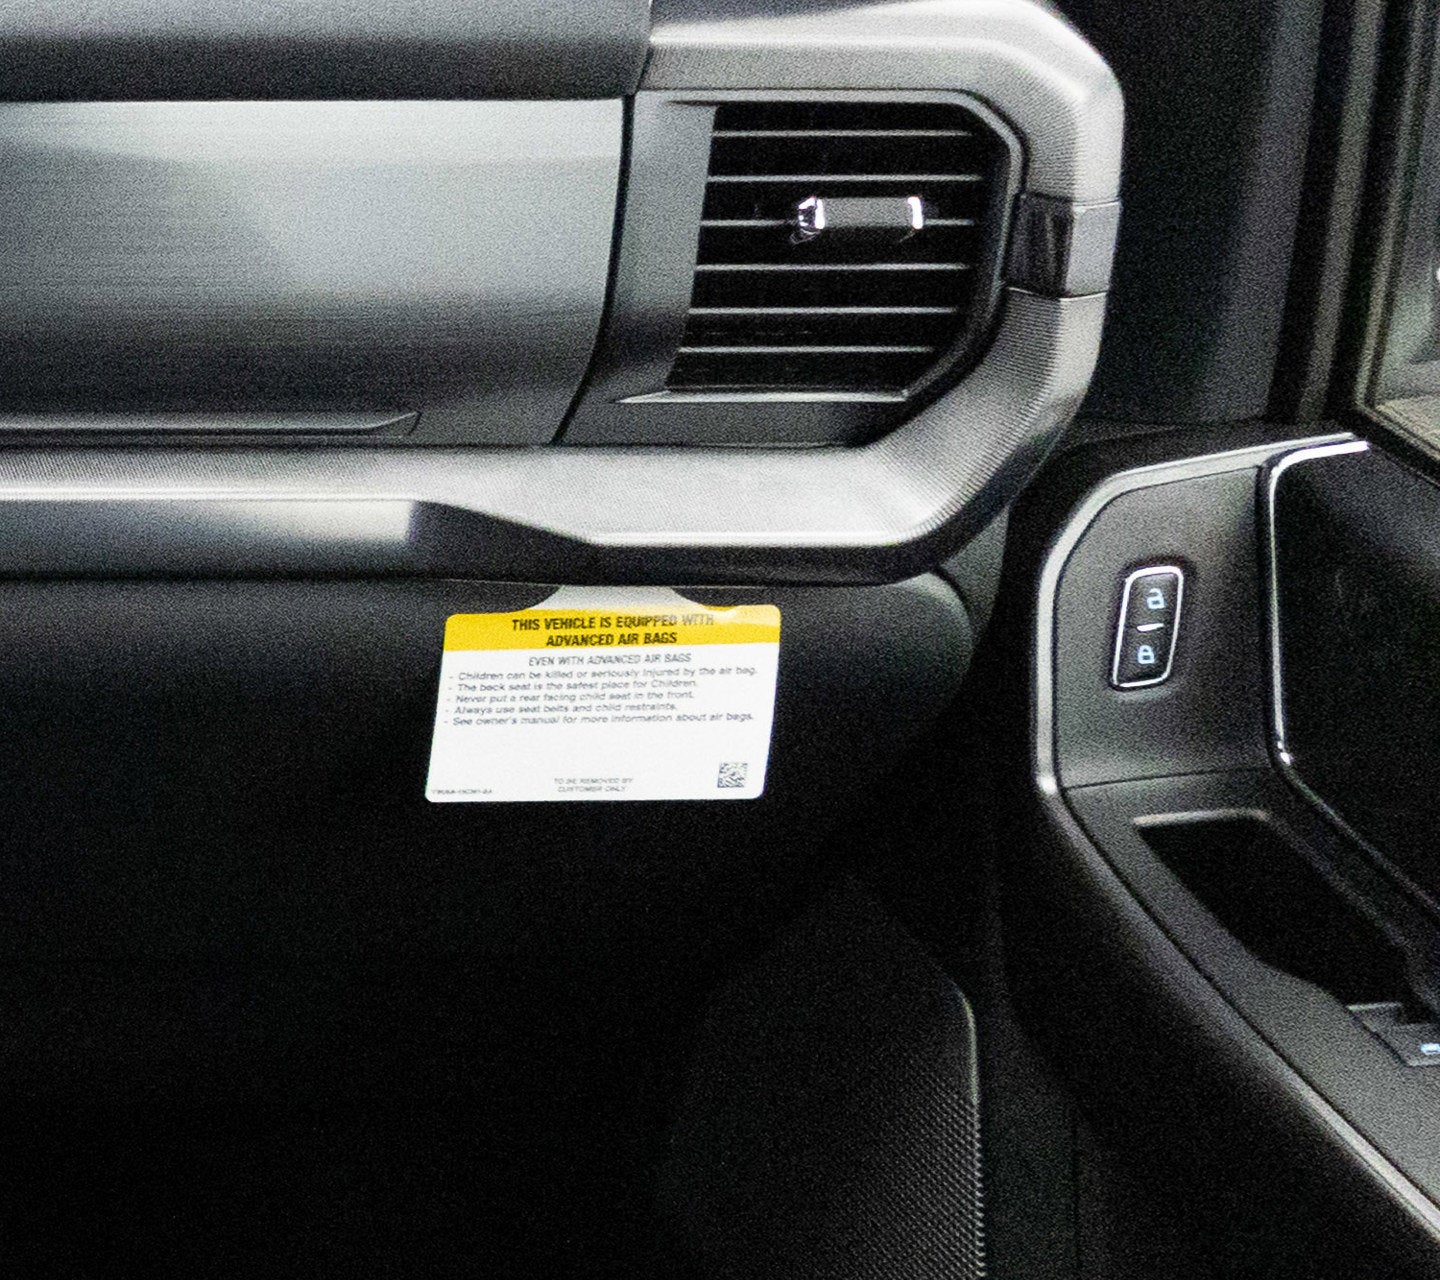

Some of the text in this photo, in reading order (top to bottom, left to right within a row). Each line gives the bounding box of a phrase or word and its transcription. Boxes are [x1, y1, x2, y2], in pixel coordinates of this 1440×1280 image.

[512, 613, 715, 631] THIS VEHICLE IS EQUIPPED WITH
[546, 632, 678, 647] ADVANCED AIR BAGS
[528, 653, 692, 667] EVEN WITH ADVANCED AIR BAGS
[458, 672, 503, 681] Children
[545, 670, 573, 679] killed
[590, 669, 639, 678] seriously
[458, 683, 476, 691] The
[570, 681, 599, 690] safest
[543, 694, 577, 703] facing
[454, 706, 493, 716] Always
[452, 717, 473, 726] See
[611, 713, 674, 722] information
[676, 712, 707, 721] about
